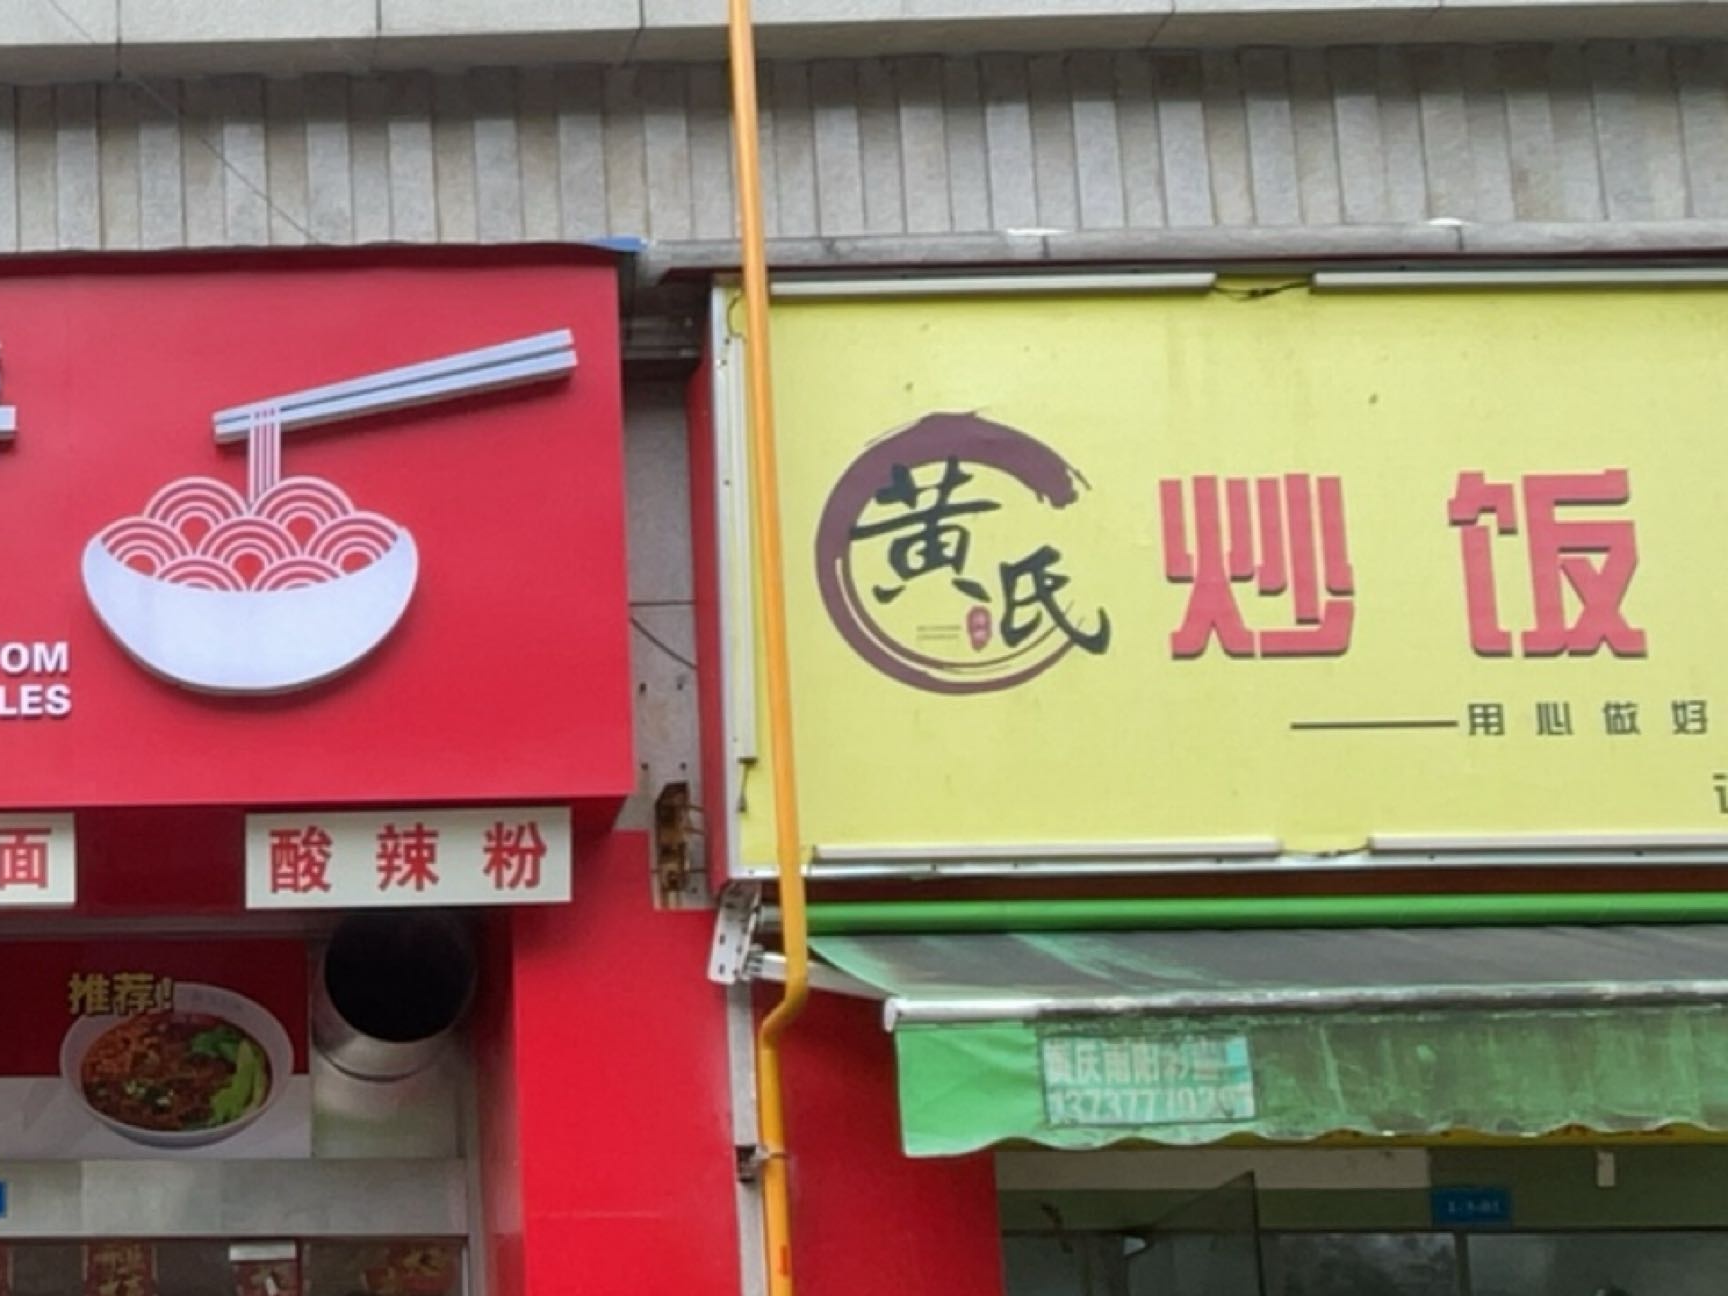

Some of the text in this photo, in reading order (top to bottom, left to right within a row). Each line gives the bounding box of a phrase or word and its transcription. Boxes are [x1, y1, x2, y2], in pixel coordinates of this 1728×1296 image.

[849, 455, 1111, 655] 黄氏
[1159, 468, 1648, 659] 炒饭
[1466, 700, 1708, 736] 用心做好
[269, 819, 547, 895] 酸辣粉
